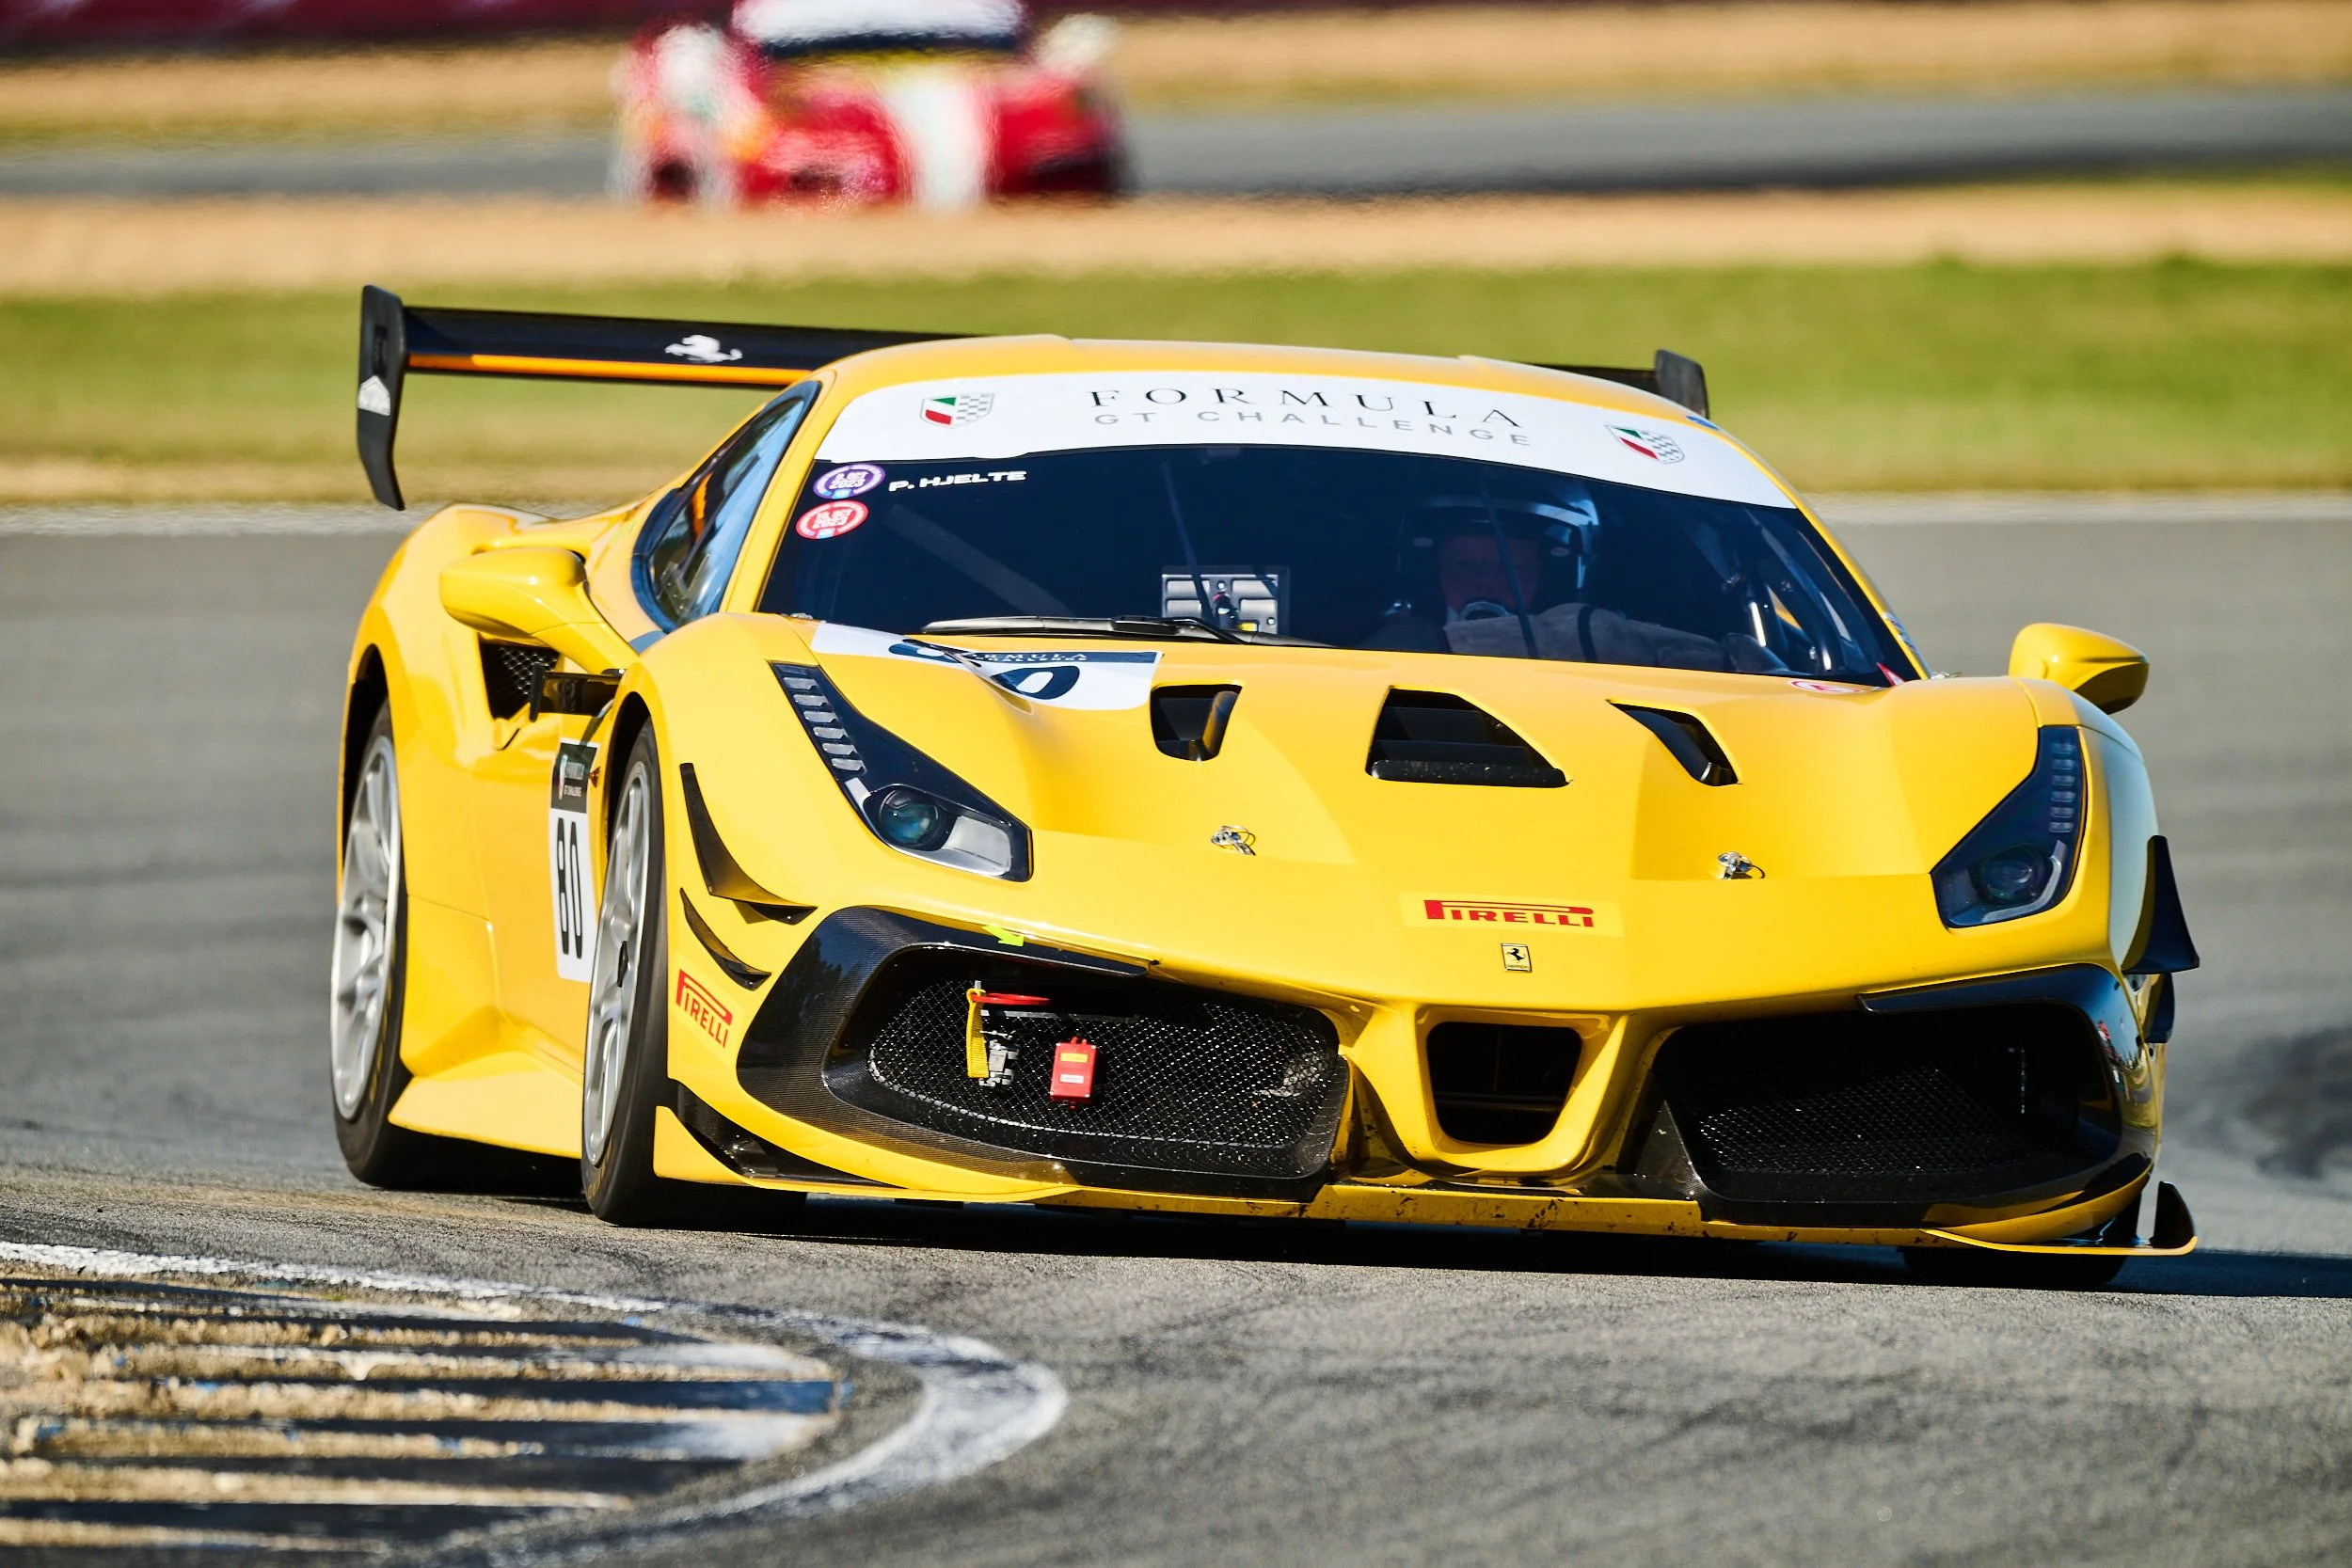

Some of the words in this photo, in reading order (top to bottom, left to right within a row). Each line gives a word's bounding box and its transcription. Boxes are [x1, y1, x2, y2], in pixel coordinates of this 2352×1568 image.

[1089, 388, 1522, 428] FORMULA
[1095, 412, 1156, 424] GT
[1197, 411, 1532, 446] CHALLENGE
[888, 480, 915, 492] P.
[919, 470, 1027, 488] HJELTE
[557, 817, 582, 959] 80
[1423, 899, 1594, 927] PIRELLI
[675, 968, 733, 1049] PIRELLI
